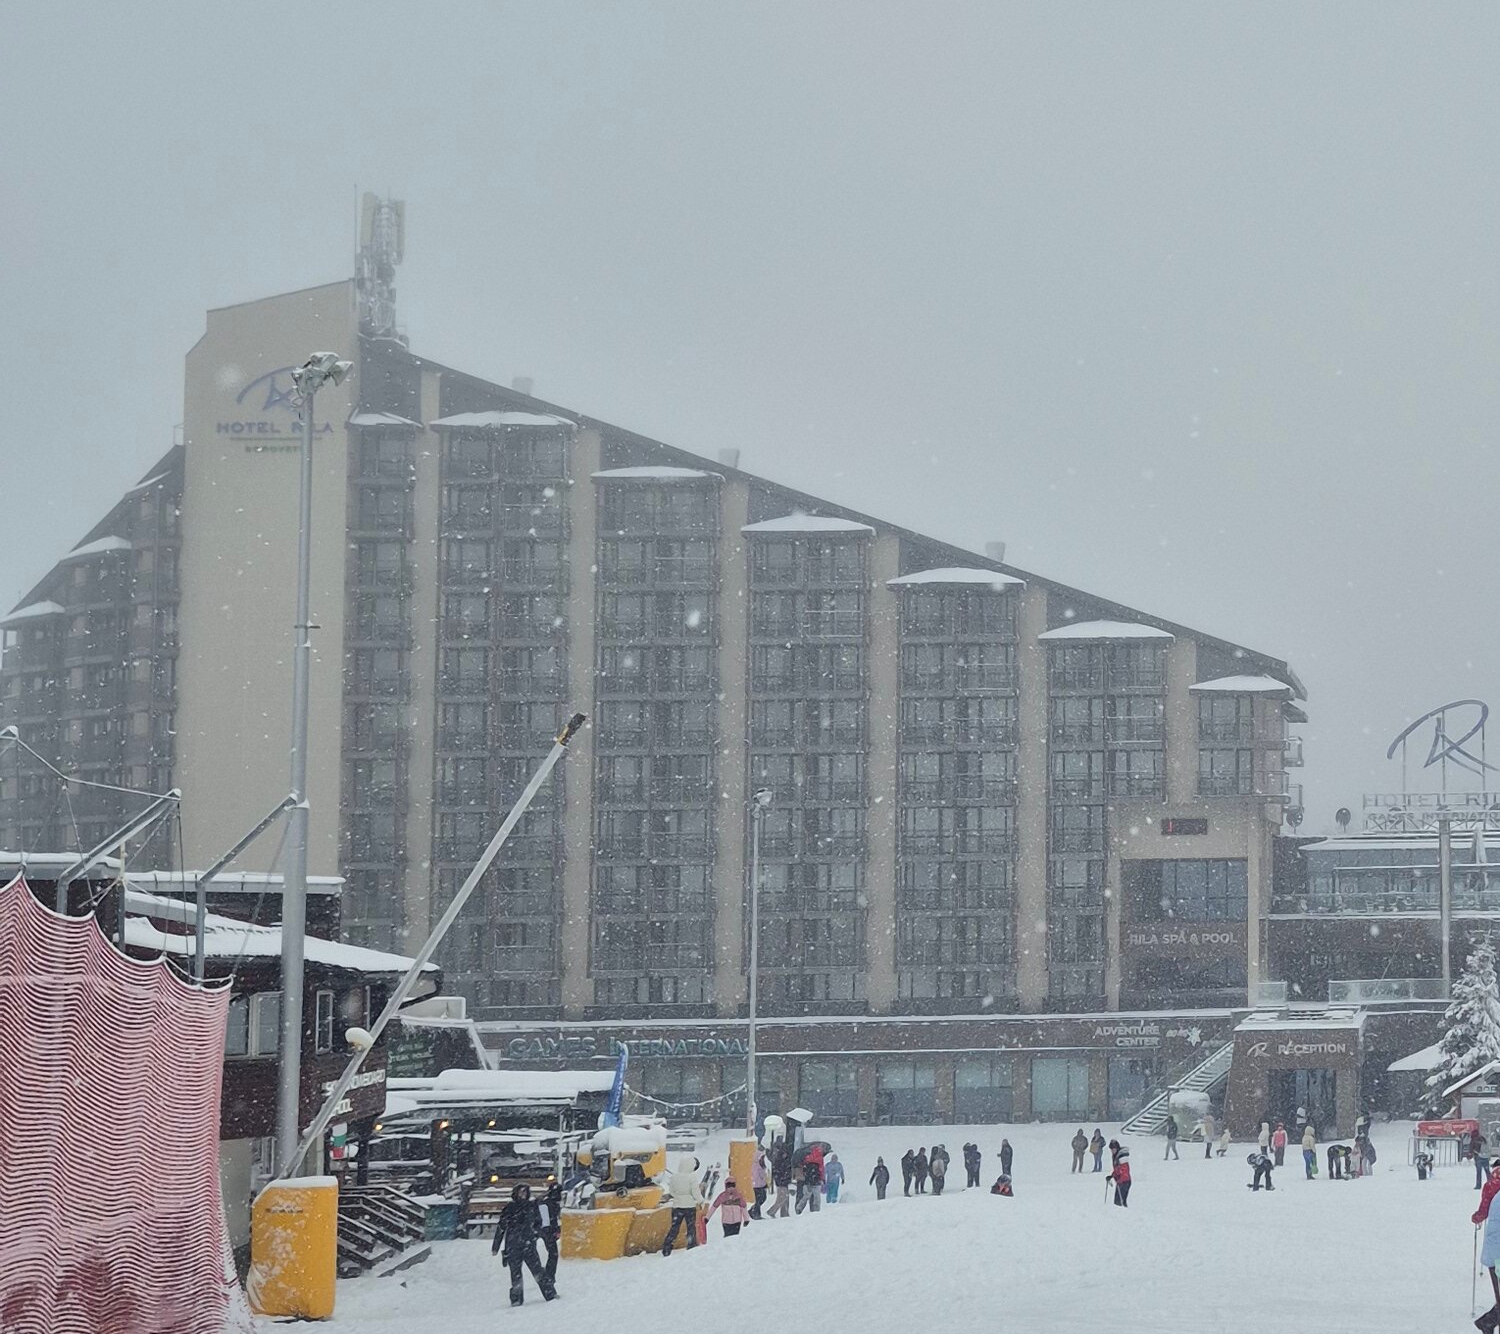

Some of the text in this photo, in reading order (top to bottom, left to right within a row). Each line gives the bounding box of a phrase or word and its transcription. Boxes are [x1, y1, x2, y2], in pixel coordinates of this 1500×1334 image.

[217, 422, 334, 433] HOTEL RLA
[245, 445, 300, 453] BOROVET
[1364, 793, 1449, 806] HOTEL
[1162, 933, 1187, 945] SPA
[1202, 932, 1237, 943] POOL
[1095, 1025, 1160, 1035] ADVENTURE
[509, 1037, 597, 1057] GAMES
[1116, 1037, 1160, 1046] CENTER
[1278, 1043, 1346, 1055] RECEPTION
